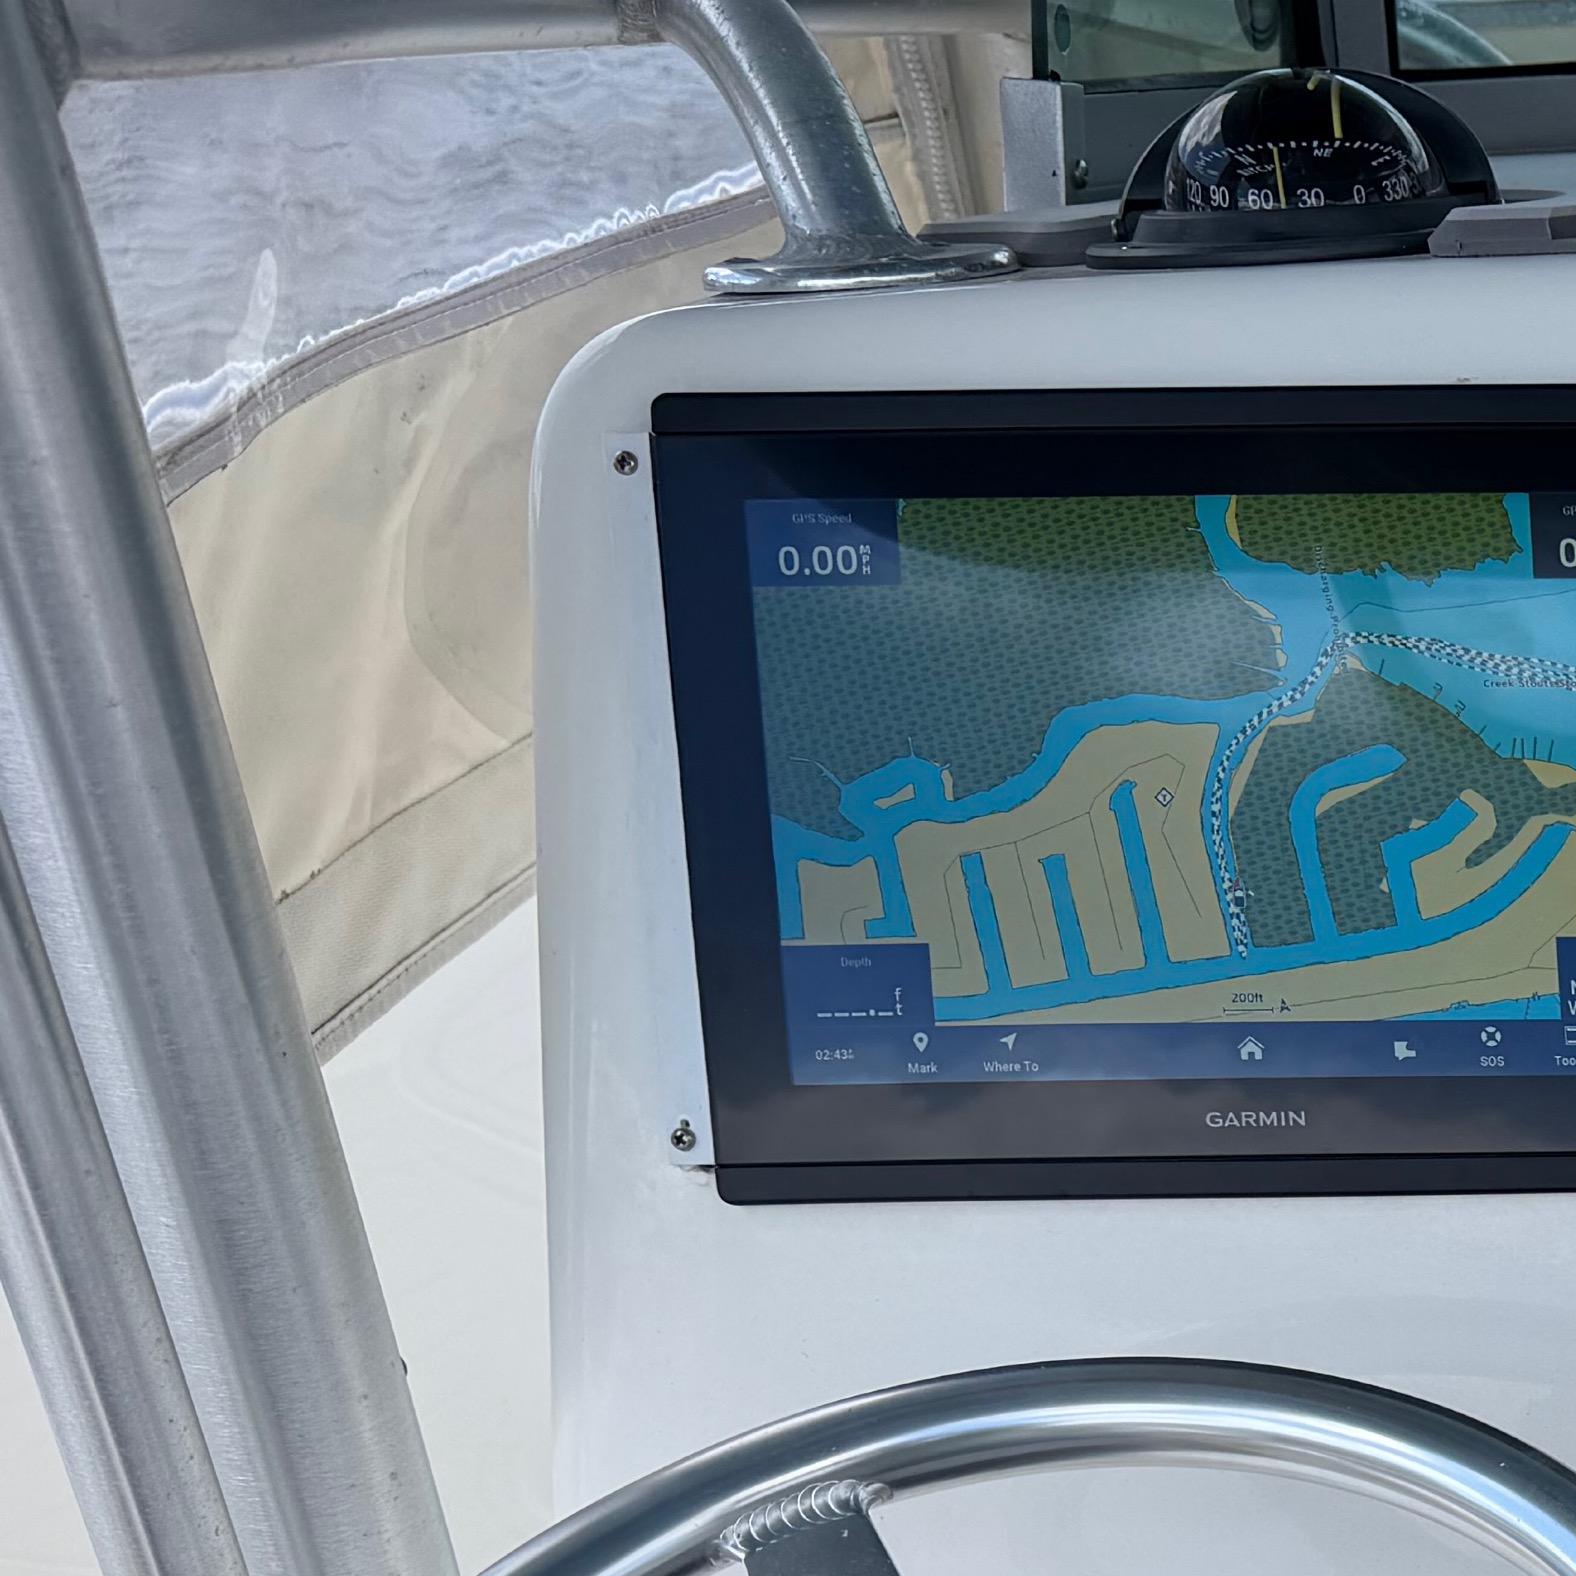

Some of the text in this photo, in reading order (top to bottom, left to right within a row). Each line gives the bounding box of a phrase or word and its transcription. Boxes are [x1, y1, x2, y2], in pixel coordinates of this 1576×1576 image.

[1313, 147, 1333, 158] NE
[1210, 185, 1229, 207] 90
[1248, 189, 1273, 209] 60
[1297, 188, 1325, 208] 30
[818, 513, 852, 524] Speed
[778, 545, 858, 575] 0.00
[841, 957, 872, 969] Depth
[1232, 992, 1263, 1003] 200ft
[908, 1062, 938, 1074] Mark
[984, 1061, 1021, 1073] Where
[1024, 1061, 1039, 1073] To
[1480, 1056, 1505, 1067] SOS
[1205, 1111, 1306, 1127] GARMIN
